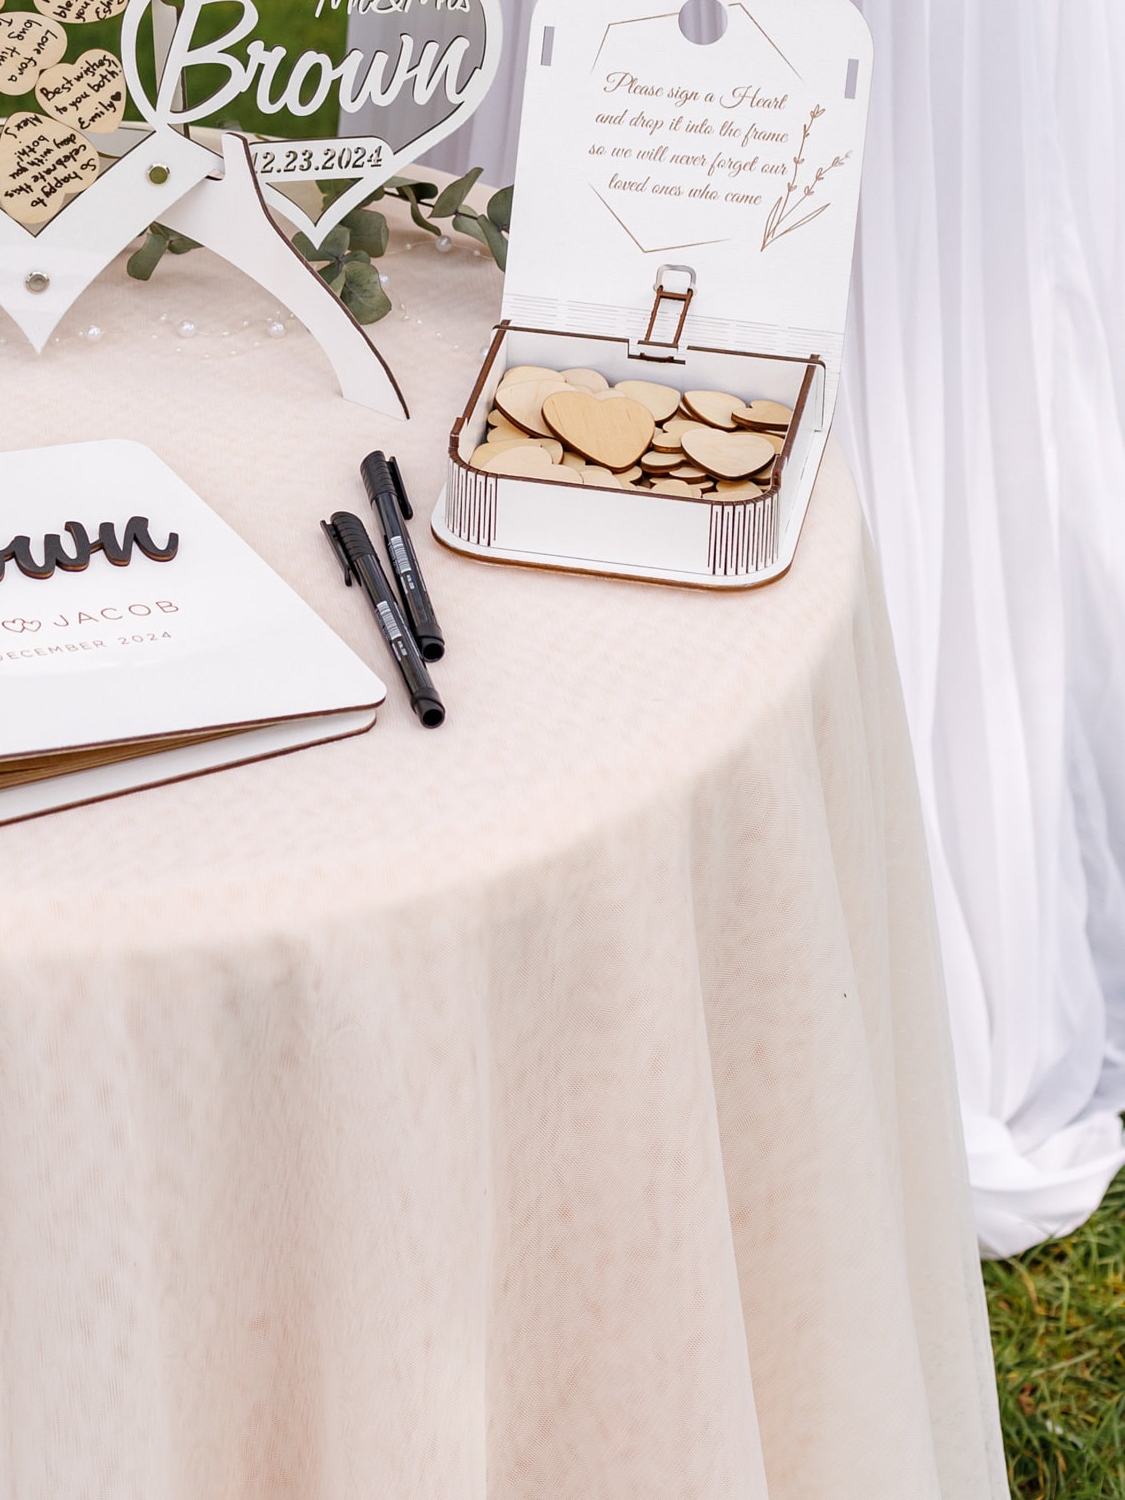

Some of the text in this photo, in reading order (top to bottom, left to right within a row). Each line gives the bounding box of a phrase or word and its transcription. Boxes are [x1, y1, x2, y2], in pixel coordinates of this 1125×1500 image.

[40, 76, 75, 101] Best
[55, 105, 69, 116] to
[68, 91, 90, 110] you
[603, 71, 789, 110] Please sign a Heart
[77, 100, 117, 130] Emily
[595, 108, 789, 147] and drop it into the frame
[588, 143, 788, 177] so we will never forget our
[608, 173, 762, 205] loved ones who came
[53, 599, 180, 629] JACOB
[117, 630, 173, 646] 2024
